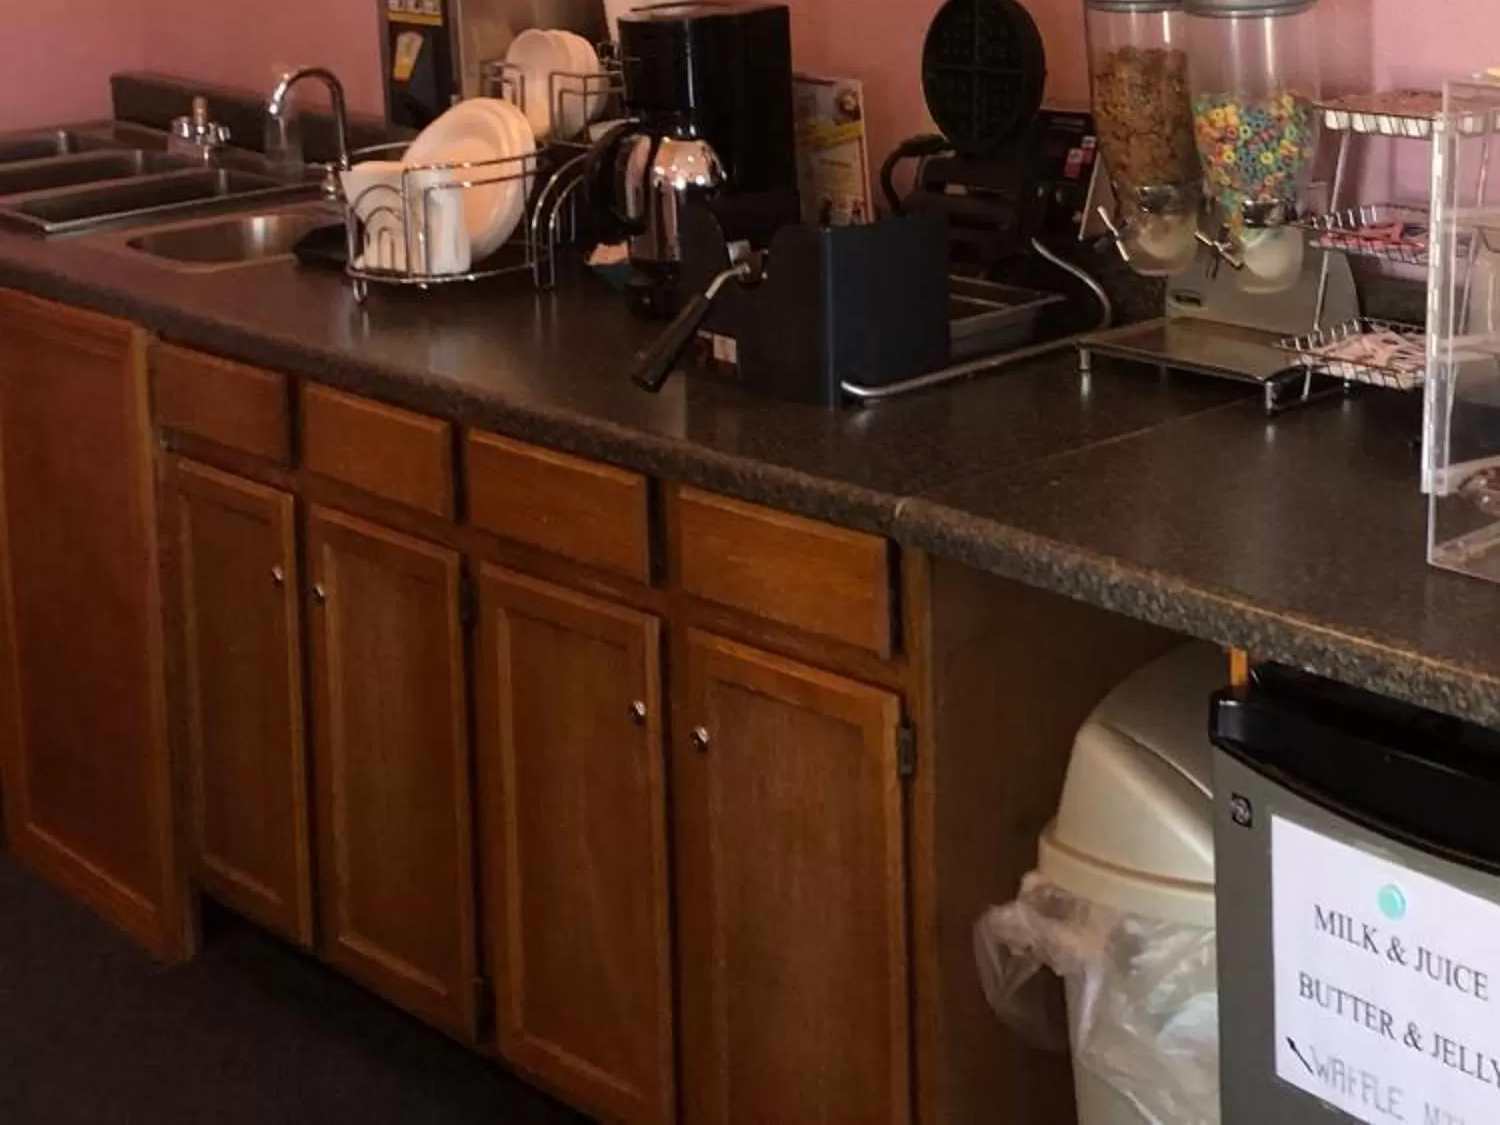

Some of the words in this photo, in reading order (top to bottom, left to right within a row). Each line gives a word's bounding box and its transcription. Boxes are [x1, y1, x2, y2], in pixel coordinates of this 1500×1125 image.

[1313, 904, 1379, 955] MILK
[1386, 936, 1407, 966] &
[1414, 946, 1489, 1001] JUICE
[1299, 971, 1397, 1040] BUTTER
[1403, 1021, 1423, 1052] &
